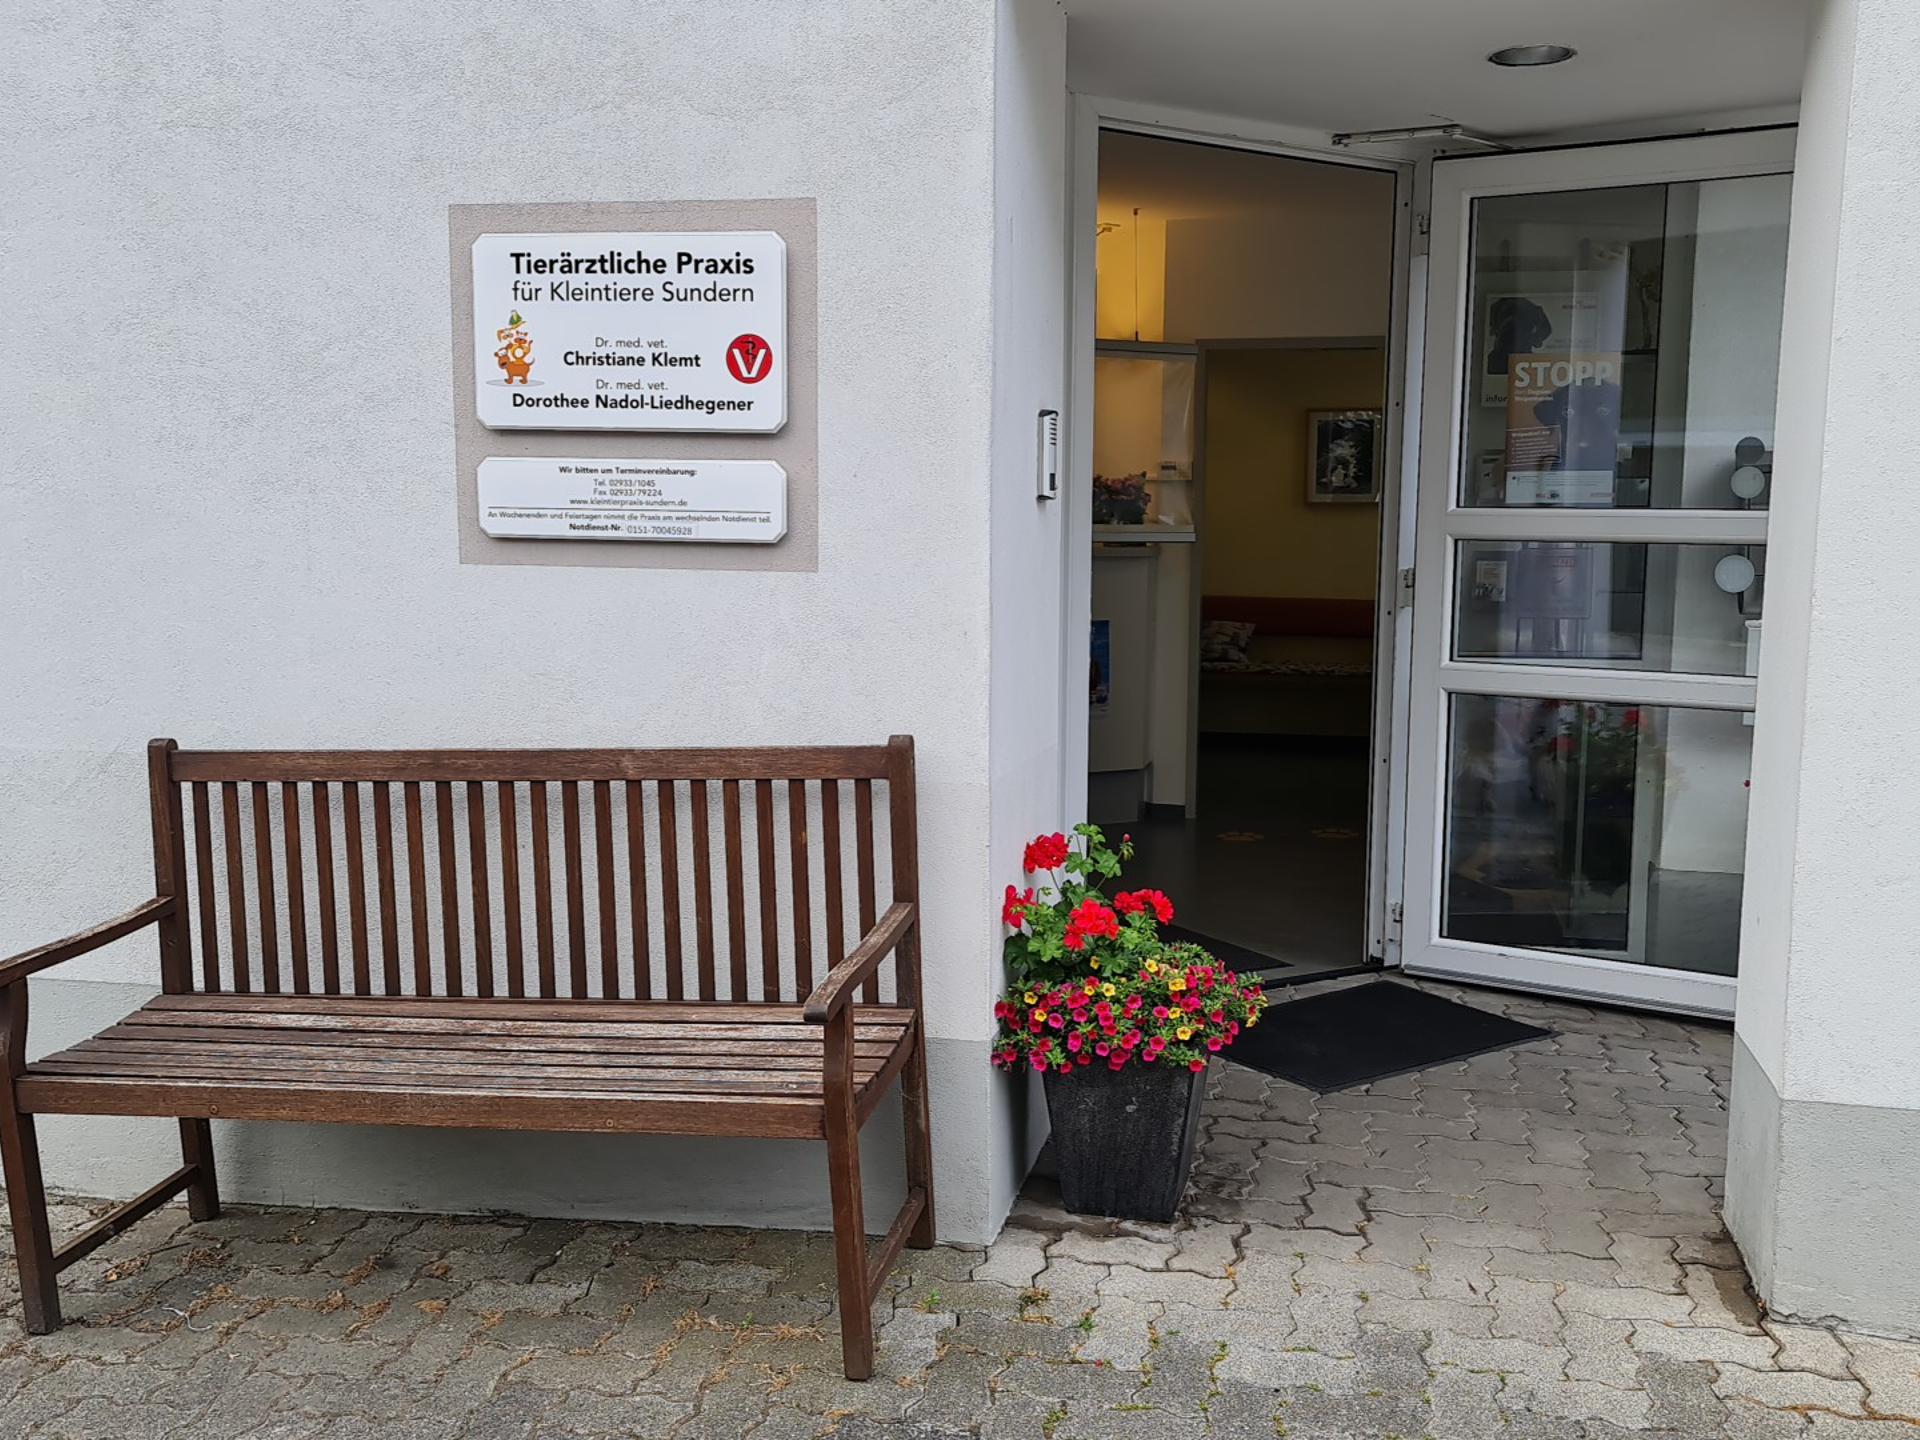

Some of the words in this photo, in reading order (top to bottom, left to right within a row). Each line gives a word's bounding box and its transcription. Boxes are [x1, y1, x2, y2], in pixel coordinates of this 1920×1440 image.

[510, 251, 667, 275] Tierärztliche
[677, 252, 755, 275] Praxis
[512, 281, 542, 302] für
[551, 281, 654, 302] Kleintiere
[662, 281, 754, 302] Sundern
[595, 337, 612, 348] Dr.
[616, 337, 643, 348] med.
[647, 338, 668, 349] vet.
[563, 351, 646, 367] Christiane
[652, 352, 701, 368] Klemt
[1514, 361, 1612, 387] STOPP
[596, 379, 613, 390] Dr.
[616, 379, 644, 390] med.
[648, 380, 669, 391] vet.
[512, 393, 589, 409] Dorothee
[595, 394, 754, 414] Nadol-Liedhegener
[559, 466, 573, 474] Wir
[575, 466, 599, 474] bitten
[616, 467, 697, 477] Terminvereinbarung:
[609, 479, 656, 488] 02933/1045
[593, 488, 607, 496] Fax
[609, 488, 662, 497] 02933/79224
[569, 498, 688, 507] www.kleintierpraxis-sundern.de
[499, 511, 548, 519] Wochenenden
[565, 512, 602, 521] Feiertagen
[675, 514, 720, 522] wechselnden
[722, 515, 757, 523] Notdienst
[569, 523, 624, 532] Notdienst-Nr.
[627, 525, 692, 535] 0151-70045928
